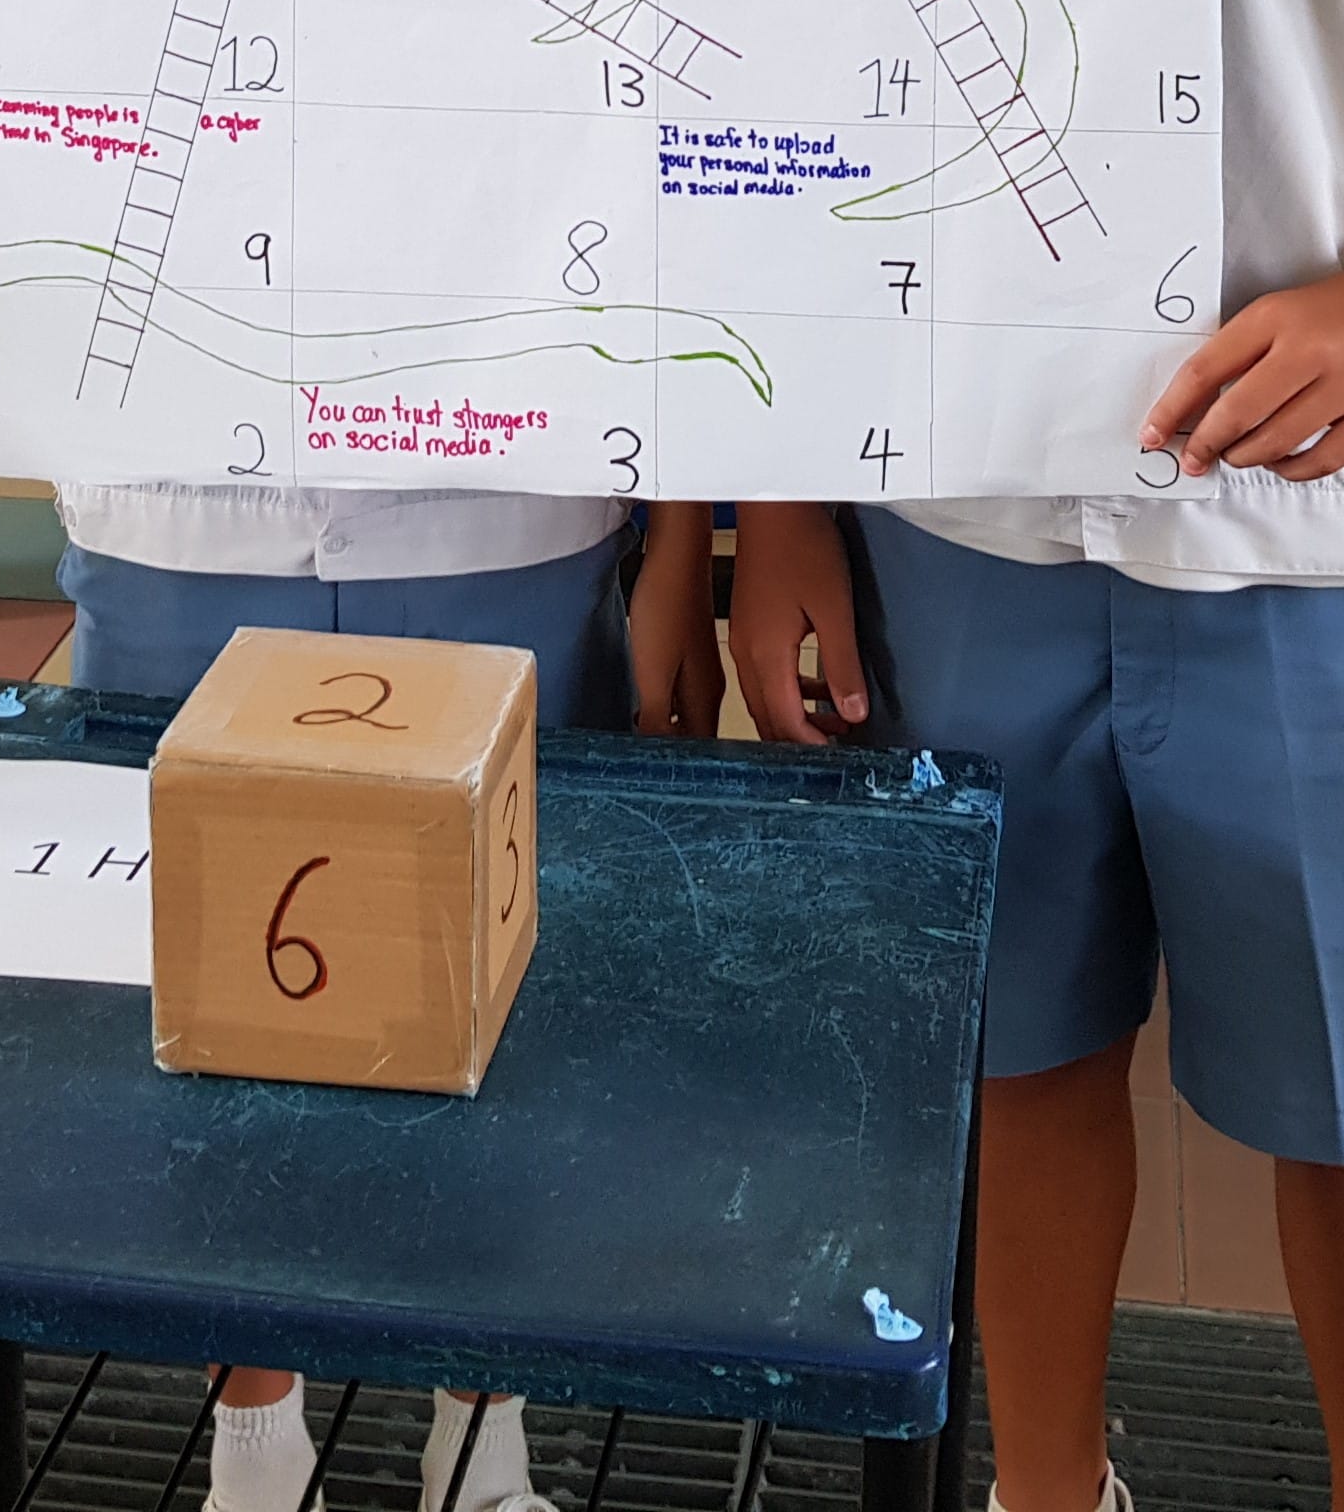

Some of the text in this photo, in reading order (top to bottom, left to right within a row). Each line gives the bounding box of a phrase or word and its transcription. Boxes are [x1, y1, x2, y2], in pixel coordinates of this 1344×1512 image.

[220, 35, 285, 93] 12
[602, 59, 645, 108] 13
[858, 57, 922, 119] 14
[65, 103, 119, 128] people
[123, 107, 140, 125] is
[199, 113, 214, 130] a
[217, 111, 262, 143] cyber
[1157, 70, 1201, 125] 15
[34, 126, 52, 144] in
[658, 124, 835, 159] It is safe to upload
[658, 151, 871, 179] your personal information
[661, 178, 739, 196] on social
[244, 232, 272, 286] 9
[562, 219, 608, 296] 8
[1155, 245, 1198, 324] 6
[880, 260, 922, 315] 7
[299, 385, 549, 441] You can trust strangers
[307, 426, 419, 455] on social
[226, 422, 274, 477] 2
[602, 426, 643, 494] 3
[859, 427, 904, 492] 4
[290, 671, 412, 732] 2
[13, 840, 152, 883] 1 H
[499, 780, 522, 926] 3
[264, 854, 332, 1002] 6
